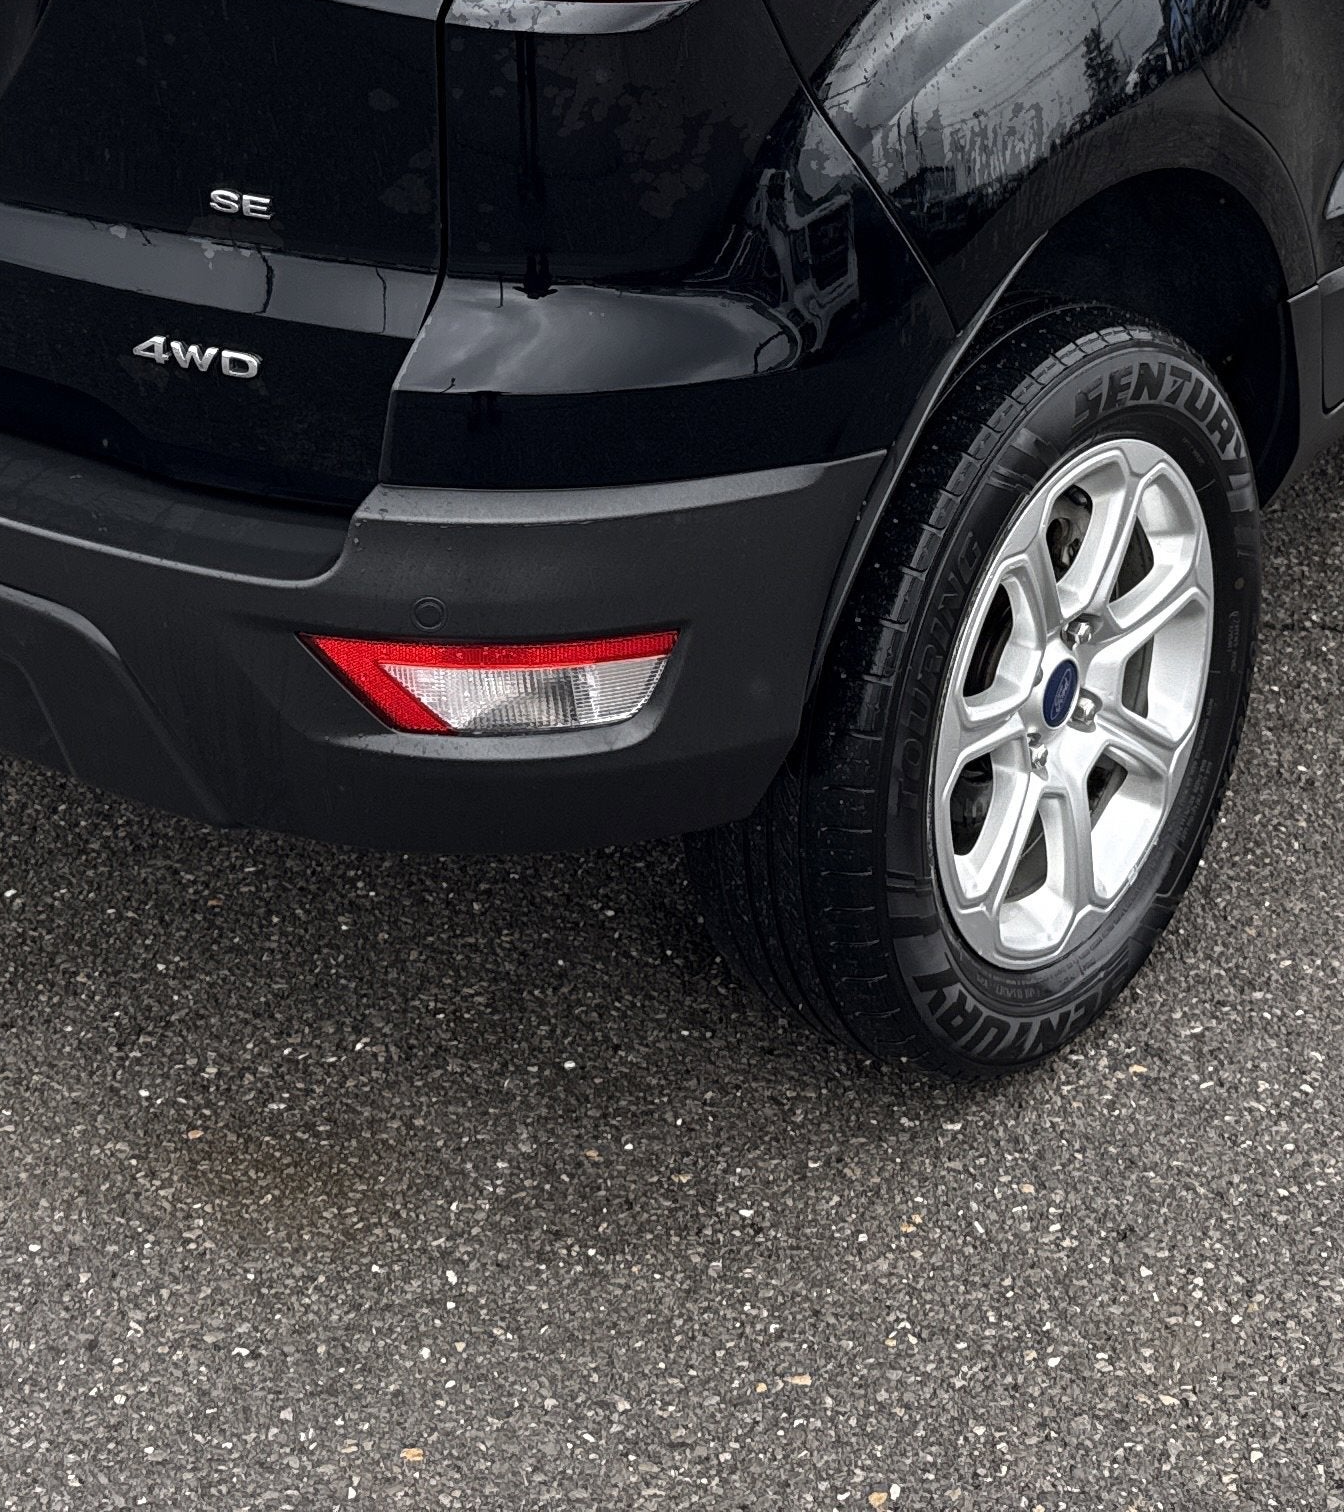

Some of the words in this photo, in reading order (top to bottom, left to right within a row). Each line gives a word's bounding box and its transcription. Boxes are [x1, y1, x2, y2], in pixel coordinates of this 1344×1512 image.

[209, 189, 272, 220] SE
[132, 335, 261, 379] 4WD
[1072, 361, 1249, 473] SENTURY
[897, 531, 982, 815] TOURING
